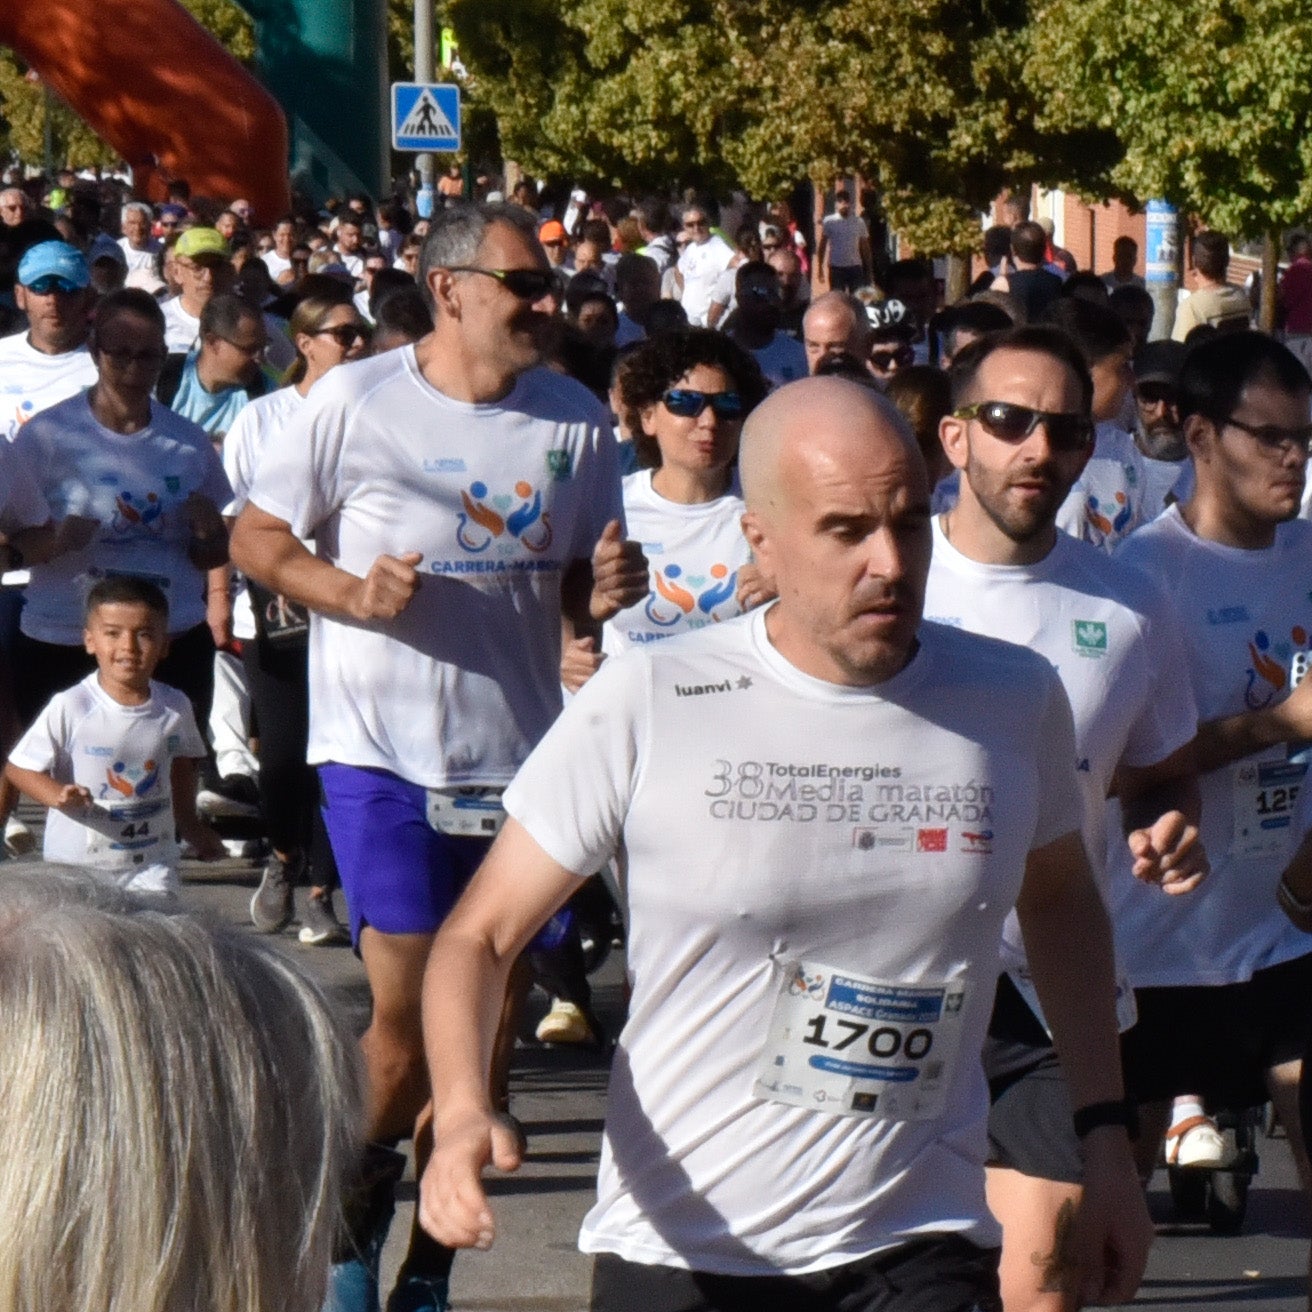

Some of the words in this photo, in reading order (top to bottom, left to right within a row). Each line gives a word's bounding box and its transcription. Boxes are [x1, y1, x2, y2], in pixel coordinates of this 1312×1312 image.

[674, 678, 731, 697] luanvi
[704, 758, 764, 799] 38
[766, 761, 902, 781] TotalEnergies
[765, 777, 864, 802] Media
[877, 779, 995, 803] maratón
[709, 799, 818, 823] CIUDAD
[825, 803, 861, 823] DE
[867, 803, 994, 823] GRANADA
[120, 821, 150, 839] 44
[828, 1000, 874, 1017] ASPACE
[803, 1013, 934, 1062] 1700
